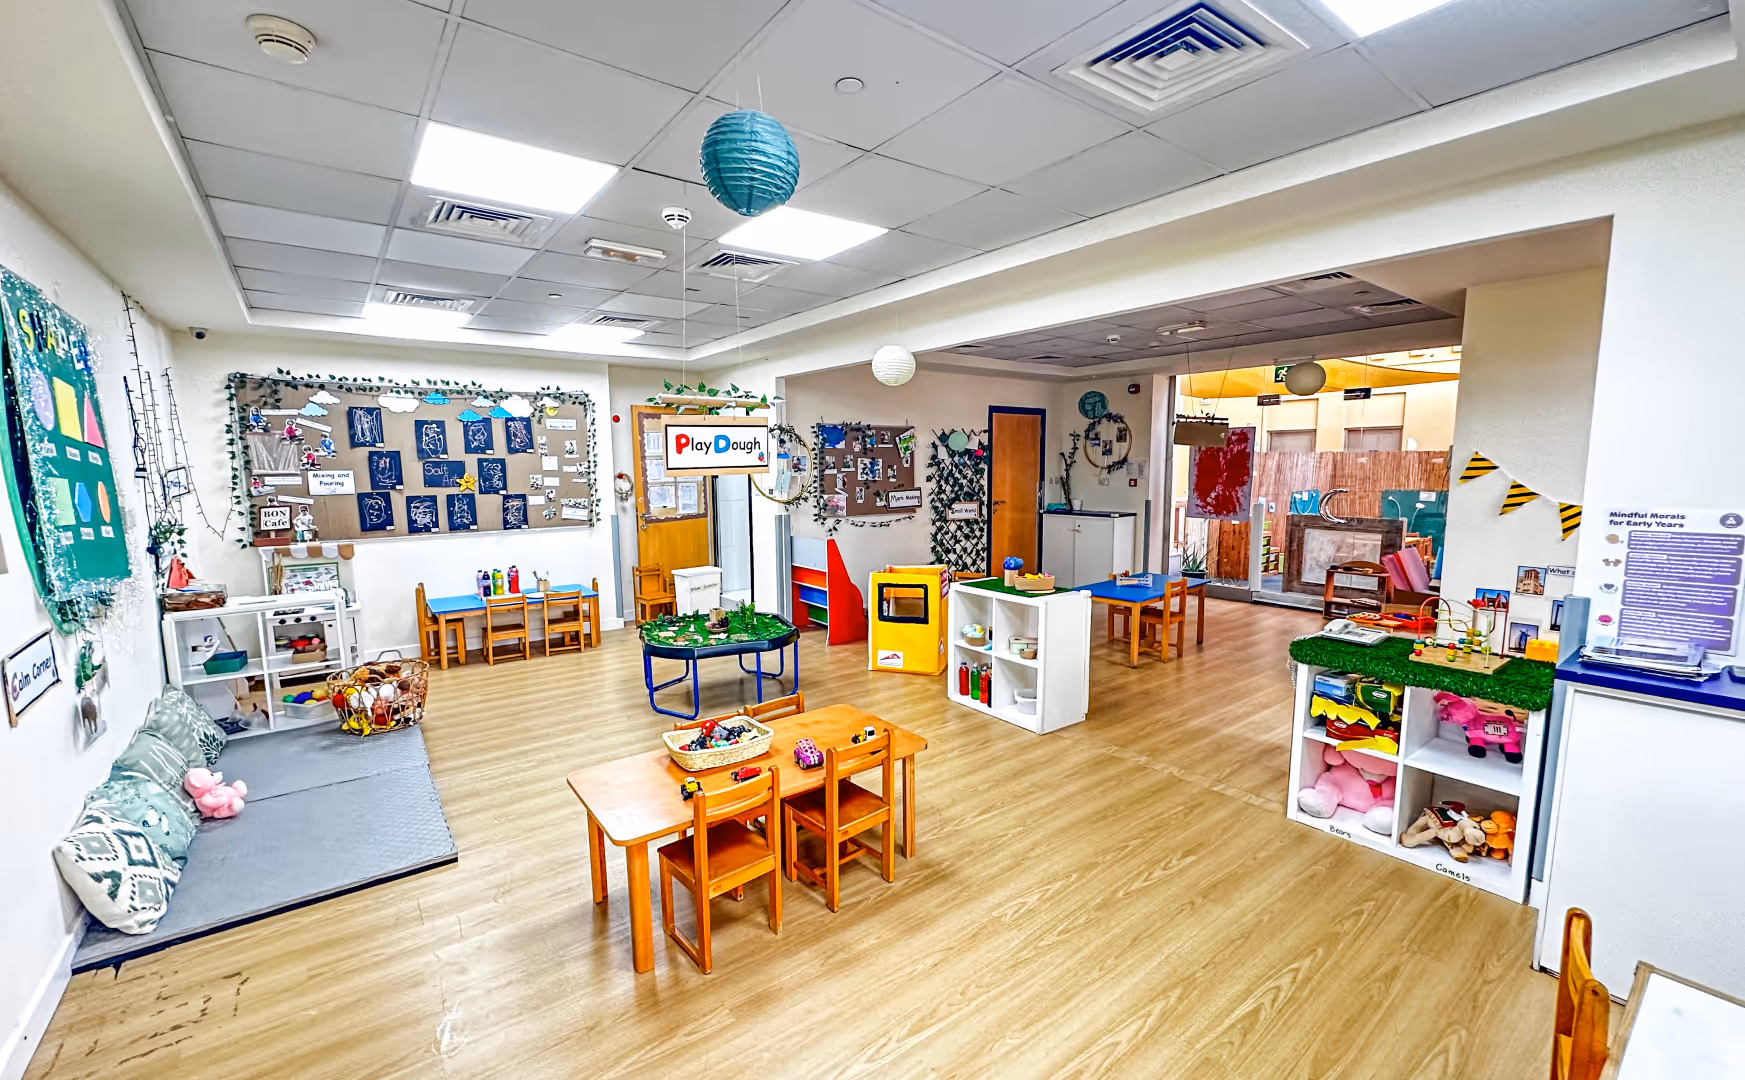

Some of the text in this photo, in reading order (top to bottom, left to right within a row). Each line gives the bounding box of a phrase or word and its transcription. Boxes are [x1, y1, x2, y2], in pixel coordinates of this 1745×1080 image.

[424, 463, 449, 475] Salt
[442, 473, 460, 487] Art
[263, 510, 287, 518] BON
[1609, 511, 1686, 520] Mindful Morals
[264, 519, 288, 527] Cafe
[1626, 520, 1653, 528] Early
[1549, 567, 1570, 575] What
[11, 671, 31, 701] Calm
[1329, 824, 1351, 838] Bears
[1435, 863, 1471, 881] Camels
